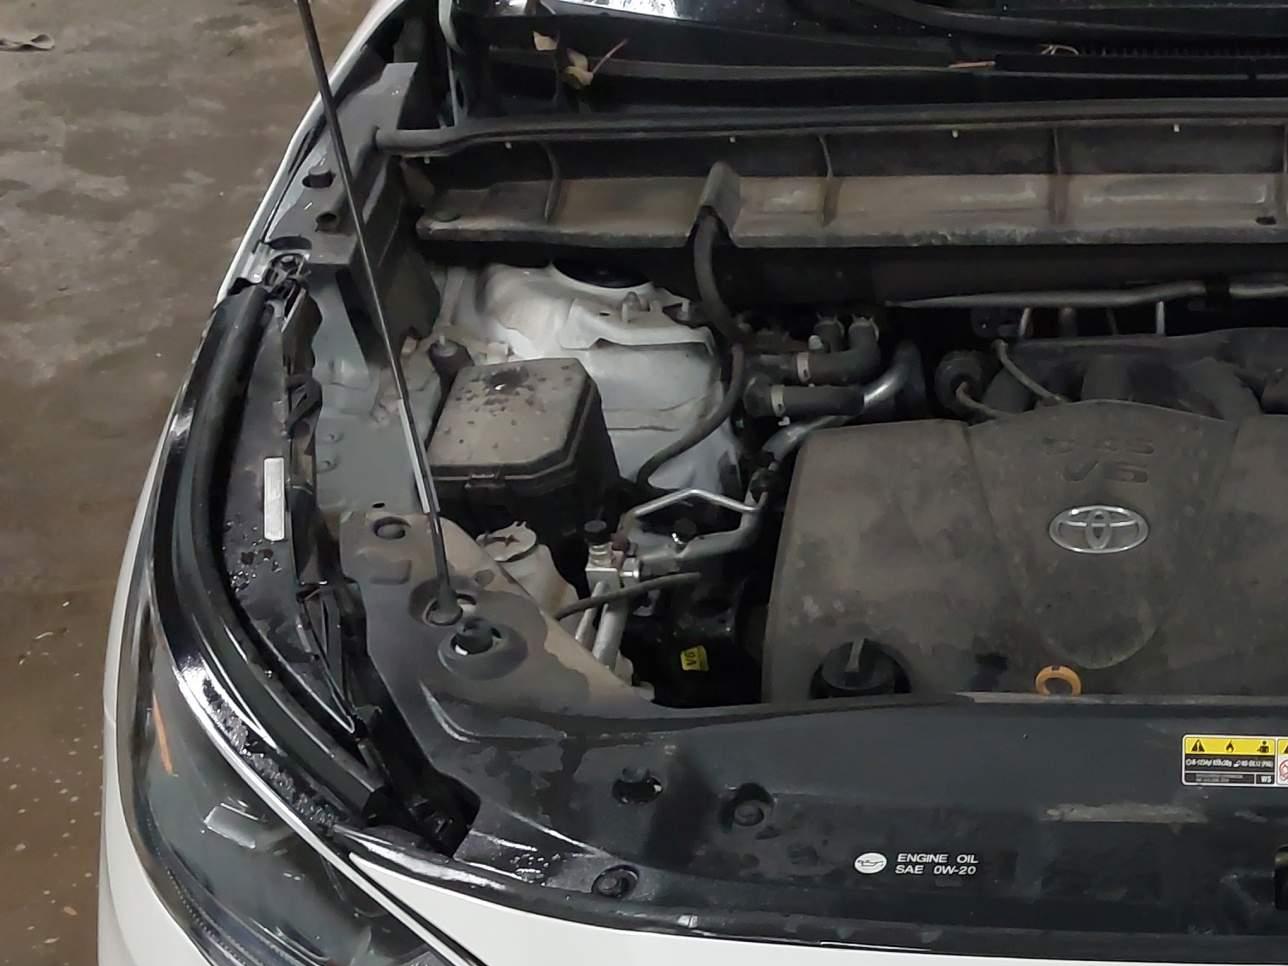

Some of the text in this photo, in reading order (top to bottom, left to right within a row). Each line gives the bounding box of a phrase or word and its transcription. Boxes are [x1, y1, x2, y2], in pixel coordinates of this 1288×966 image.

[1062, 458, 1149, 484] V6
[897, 853, 979, 864] ENGINE OIL
[895, 864, 977, 875] SAE 0W-20
